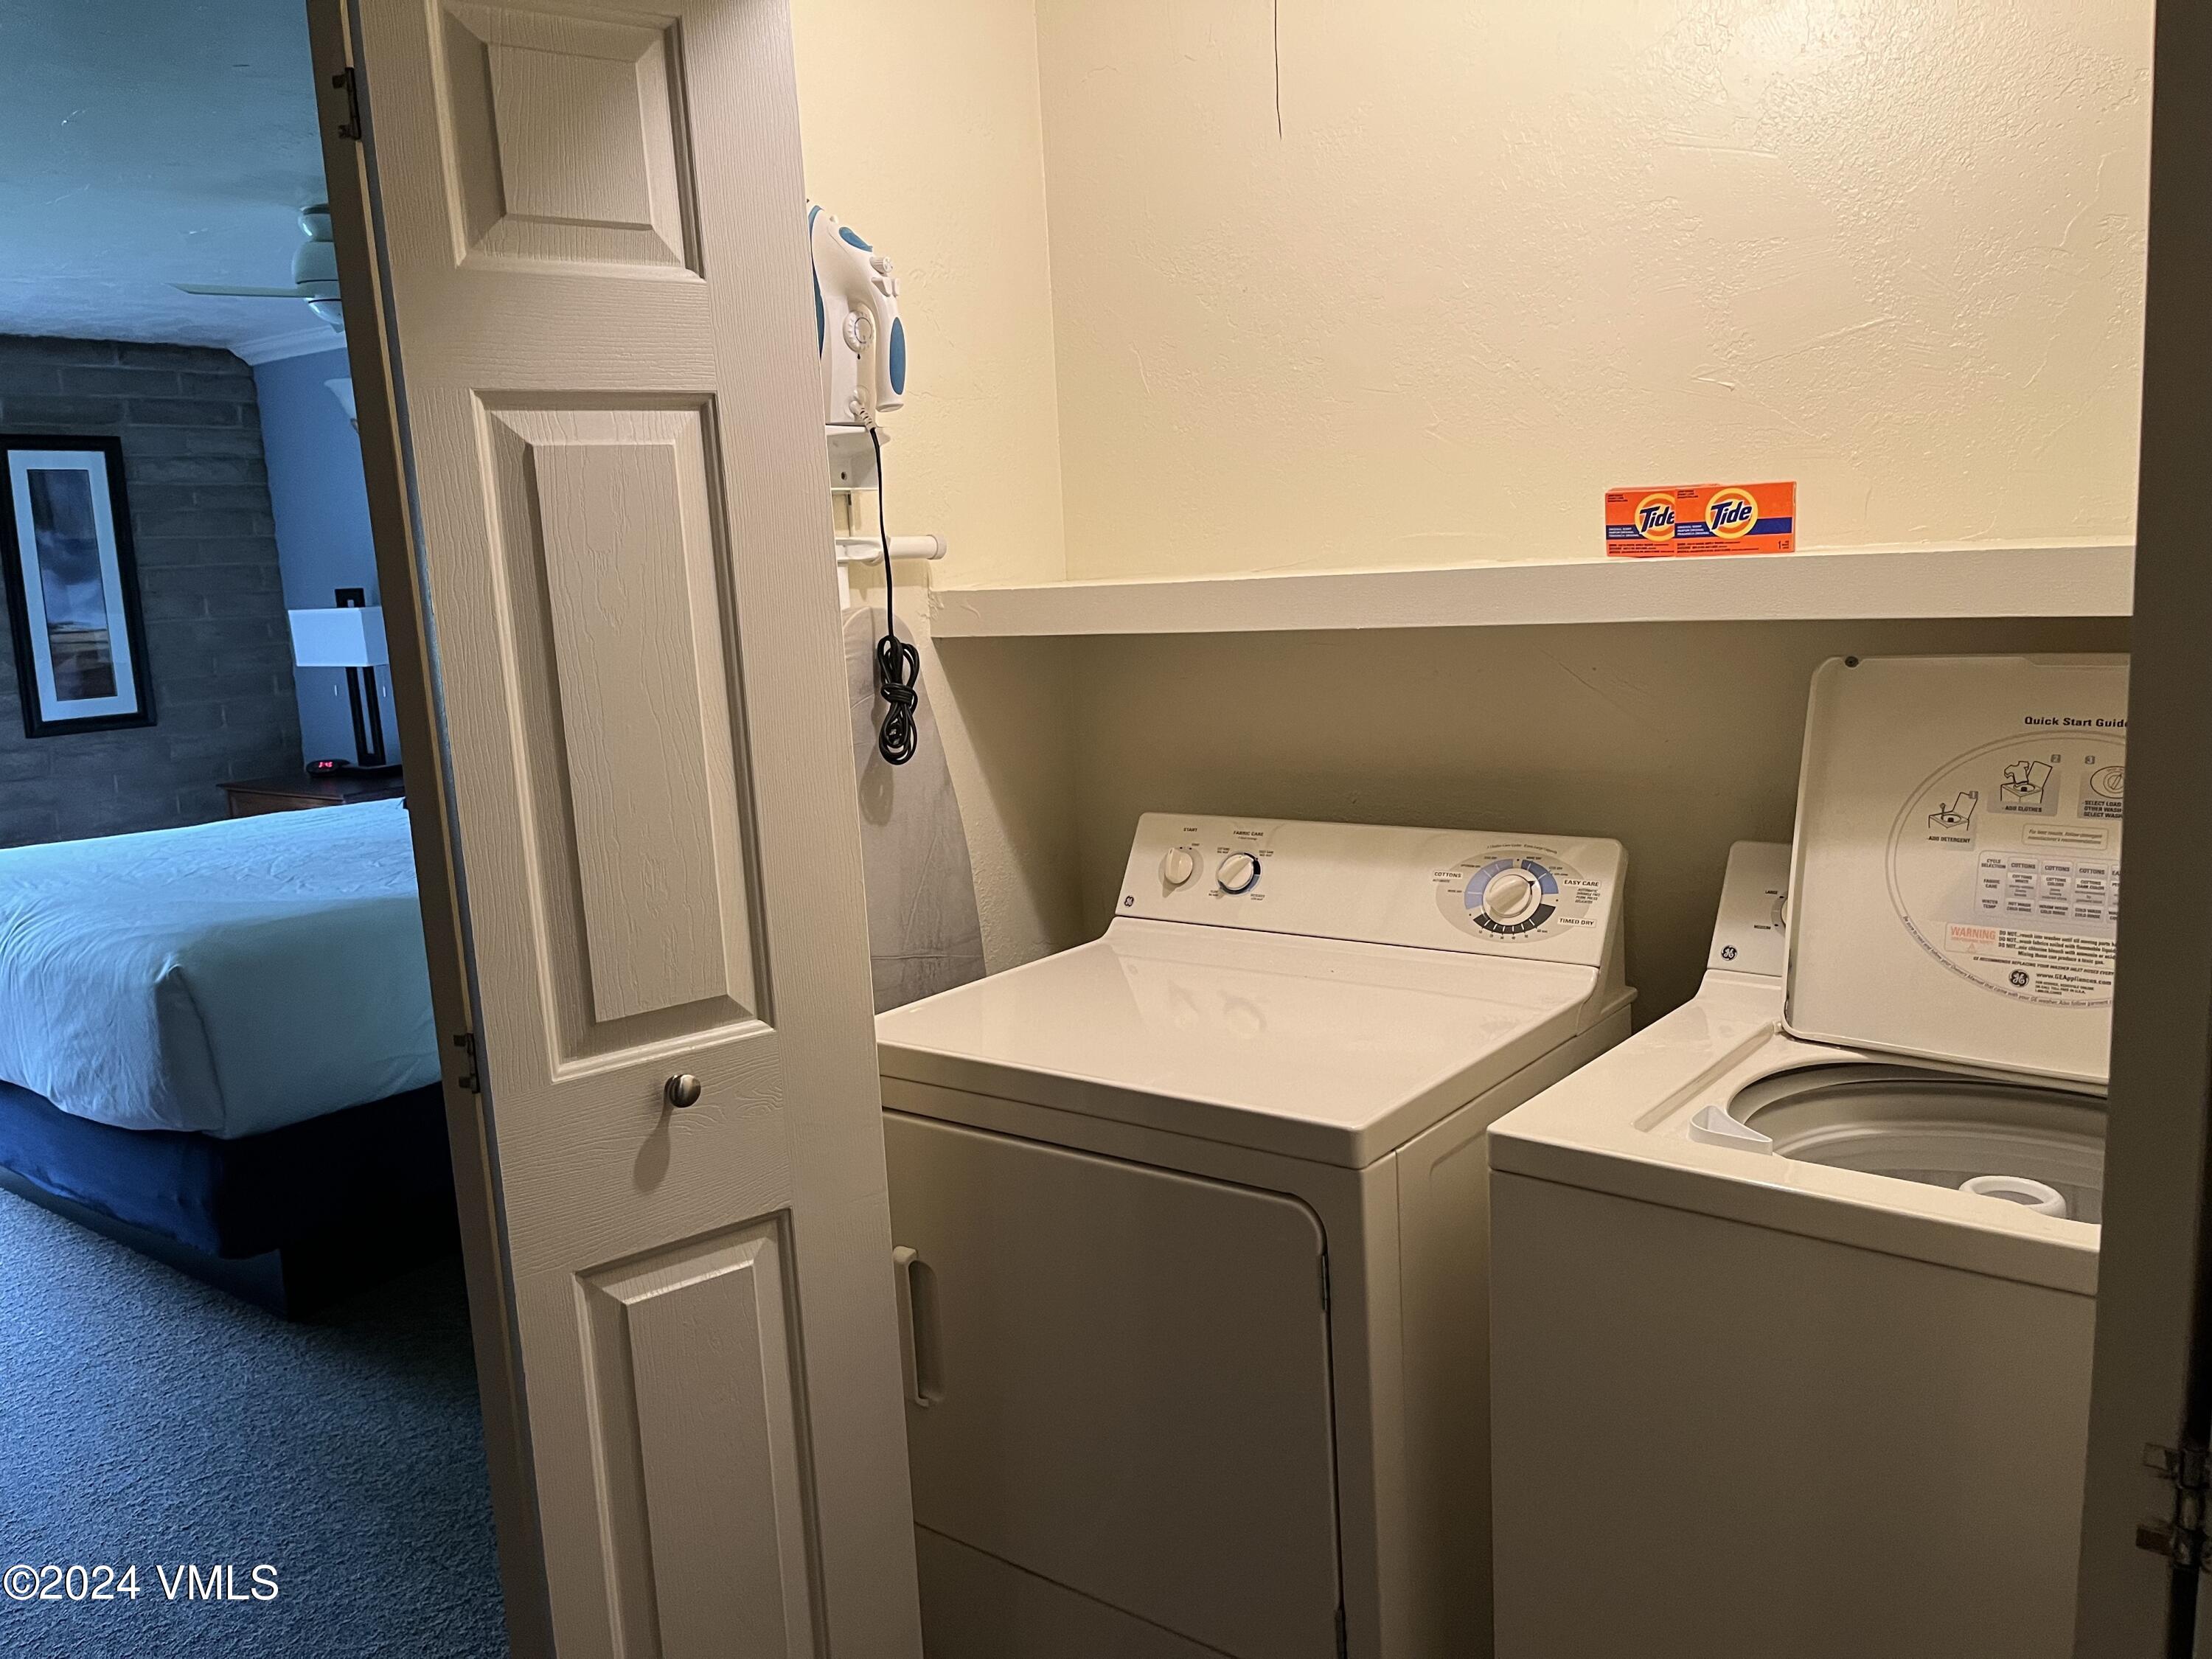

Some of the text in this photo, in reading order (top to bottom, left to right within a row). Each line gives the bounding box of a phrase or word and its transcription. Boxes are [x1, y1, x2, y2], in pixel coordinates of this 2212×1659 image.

[1640, 506, 1674, 532] Tide
[1711, 501, 1752, 529] Tide
[2025, 717, 2059, 726] Quick
[2063, 717, 2092, 726] Start
[1951, 926, 1996, 939] WARNING
[2037, 973, 2112, 985] www.GEAppliances.com
